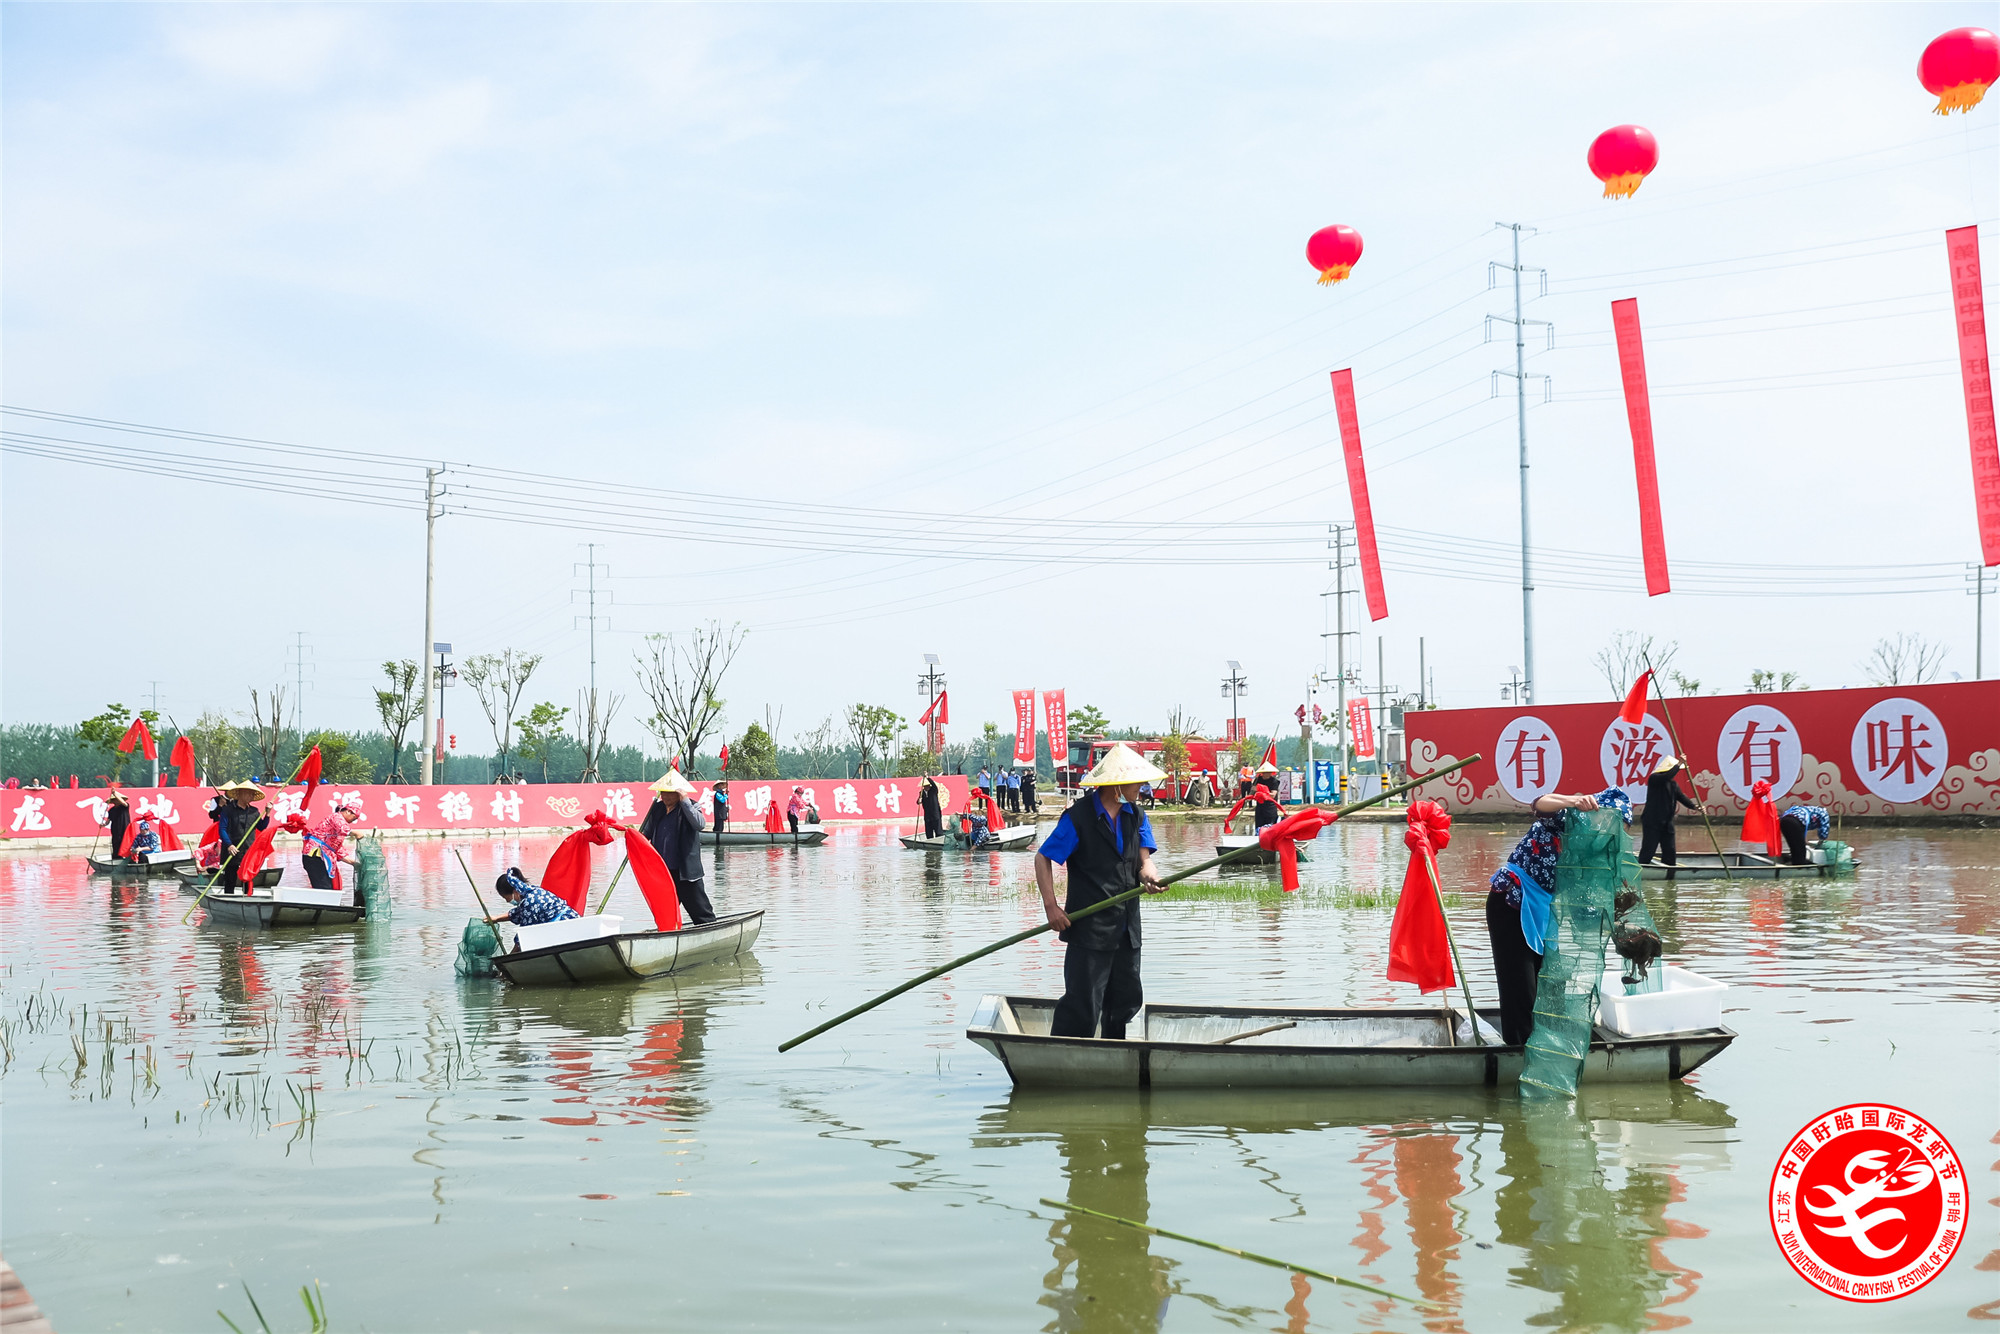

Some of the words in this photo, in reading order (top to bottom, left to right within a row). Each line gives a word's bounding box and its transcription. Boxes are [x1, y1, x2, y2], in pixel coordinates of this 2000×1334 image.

[1504, 714, 1937, 790] 有滋有味
[603, 782, 902, 821] 淮明祖陵村
